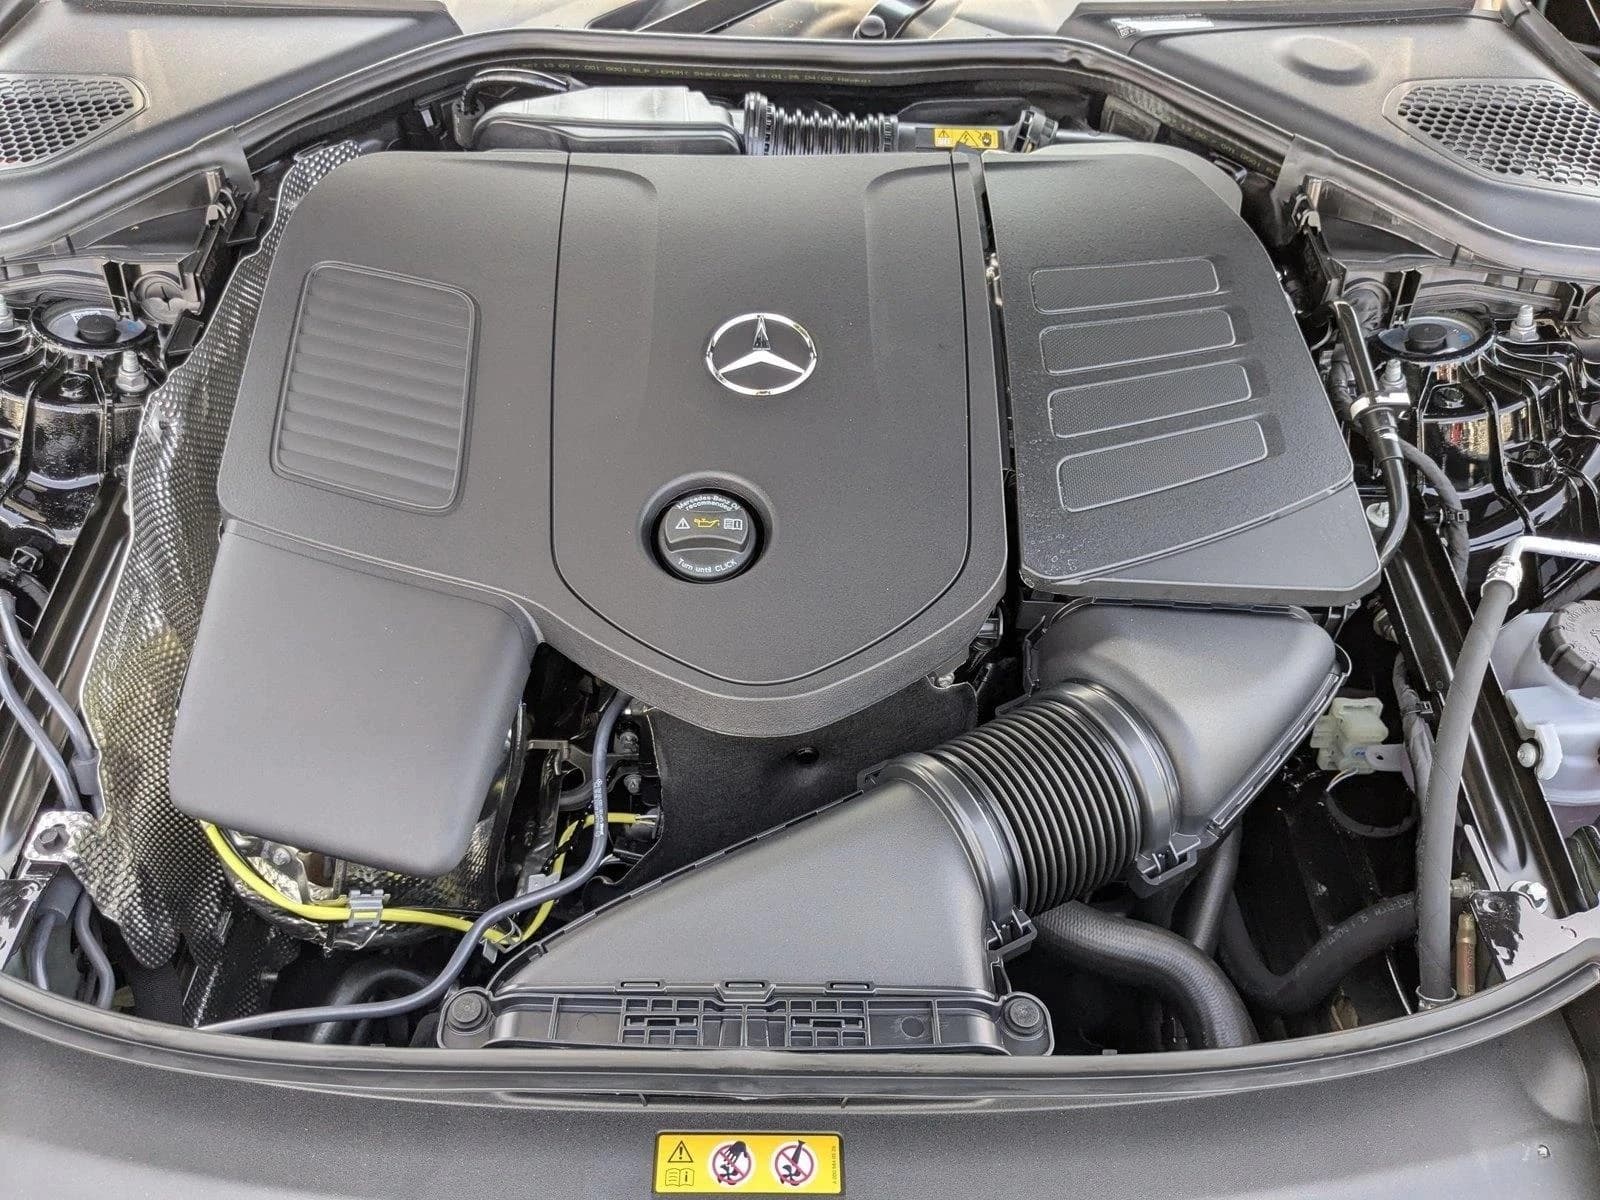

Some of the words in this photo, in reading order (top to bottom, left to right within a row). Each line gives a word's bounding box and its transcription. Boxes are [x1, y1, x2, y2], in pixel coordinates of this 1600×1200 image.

[676, 495, 730, 510] Mercedes-Benz
[678, 558, 693, 571] Turn
[695, 565, 712, 574] until
[715, 559, 737, 572] CLICK
